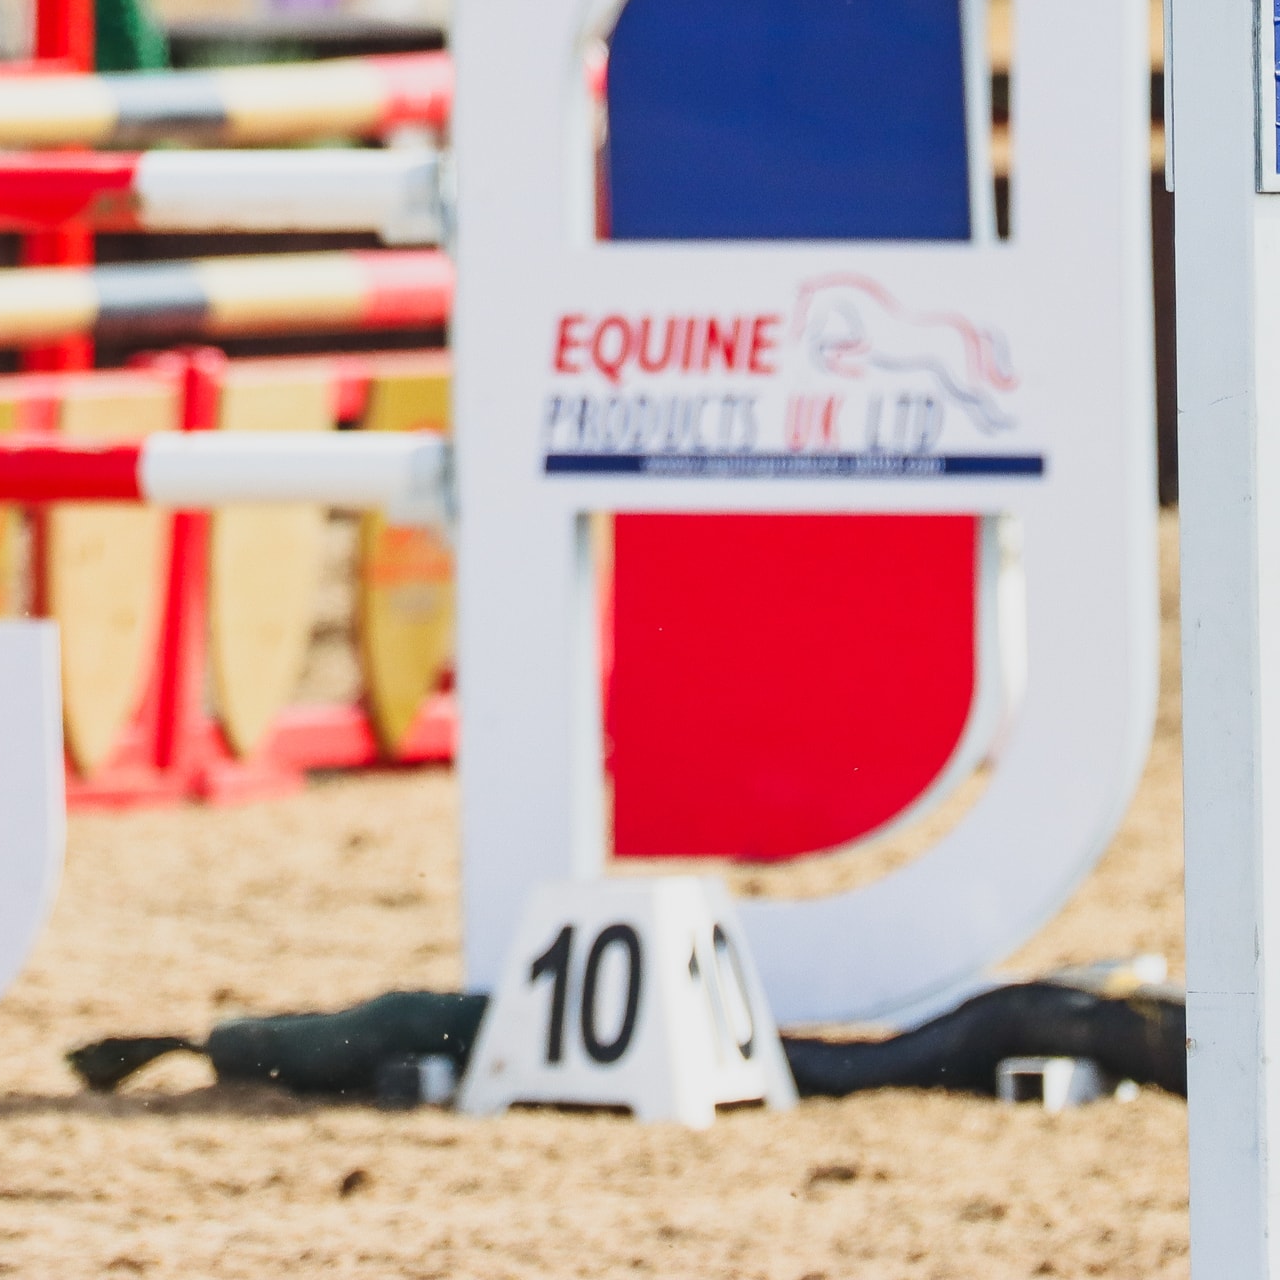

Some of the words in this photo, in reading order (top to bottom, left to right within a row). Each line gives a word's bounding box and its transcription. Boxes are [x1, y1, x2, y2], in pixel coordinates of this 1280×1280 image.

[553, 313, 781, 385] EQUINE
[542, 393, 758, 454] PRODUCTS
[784, 393, 844, 454] UK
[864, 393, 944, 454] LTD
[530, 923, 643, 1065] 10
